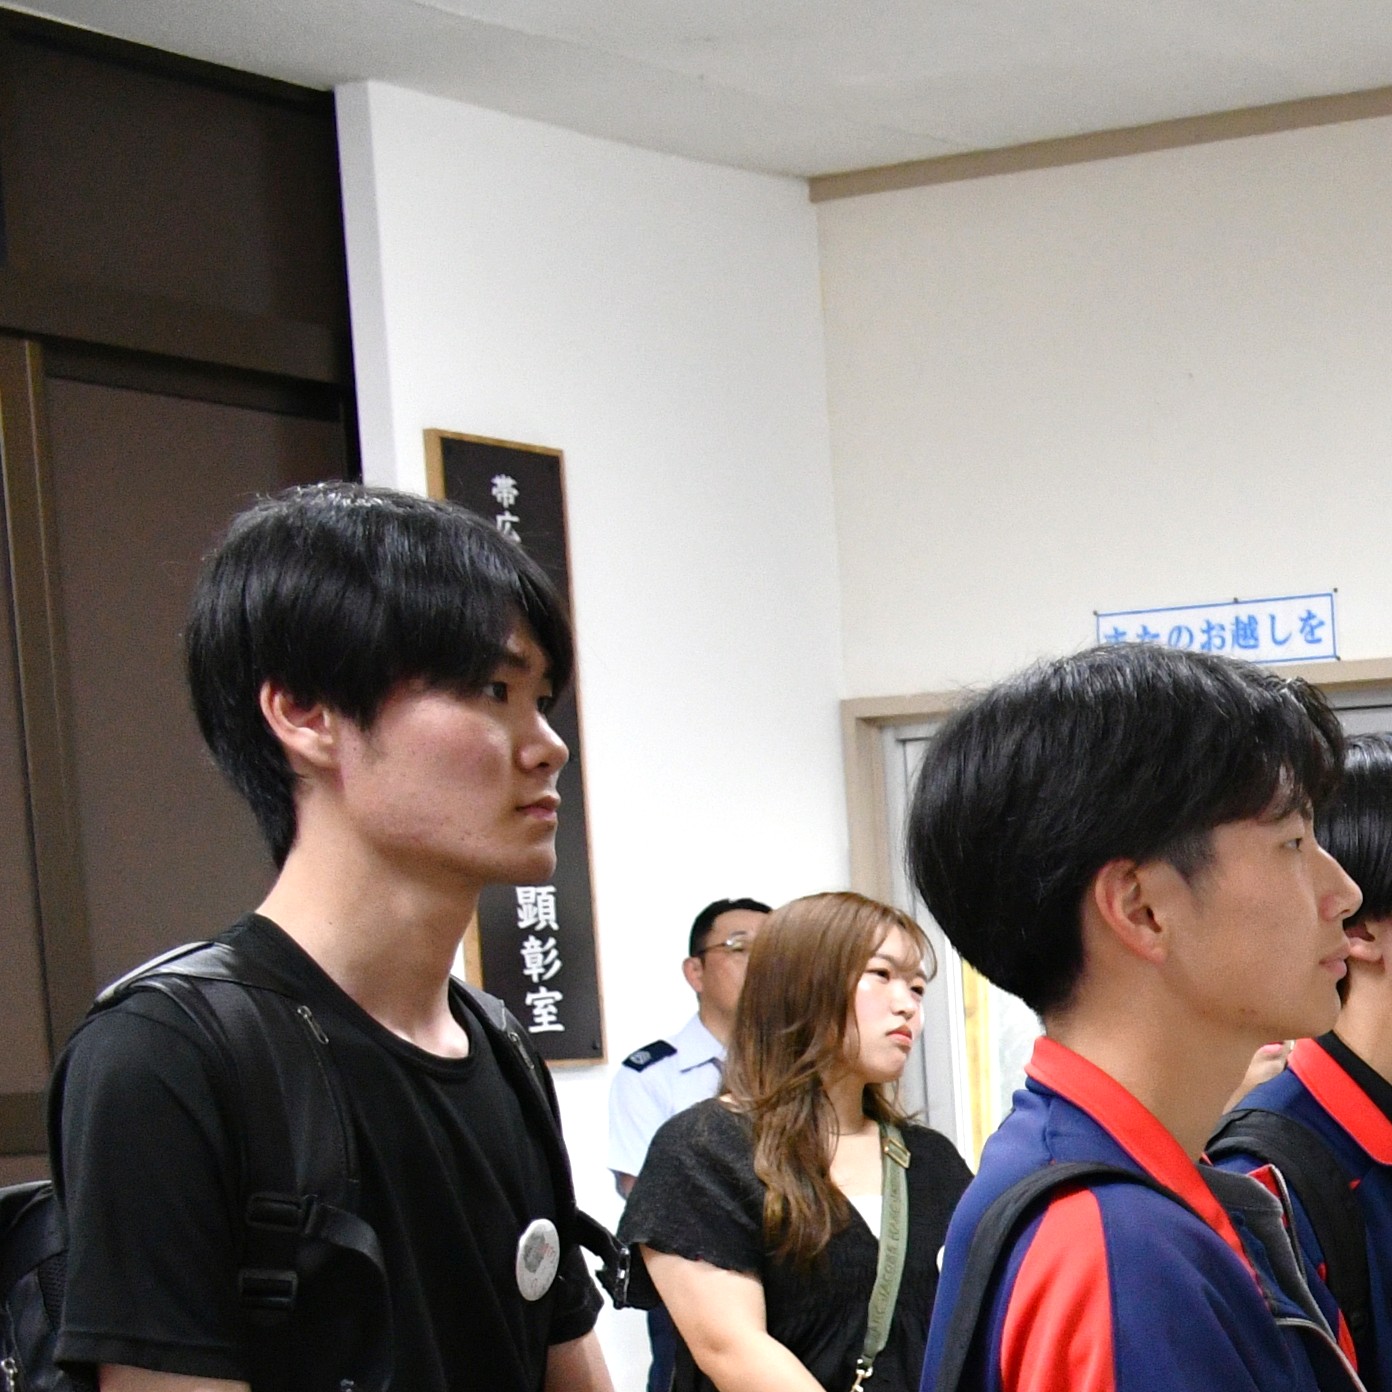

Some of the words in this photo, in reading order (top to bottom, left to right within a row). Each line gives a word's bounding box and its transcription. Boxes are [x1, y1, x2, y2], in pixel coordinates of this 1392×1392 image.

[490, 473, 522, 543] 帯広
[515, 884, 566, 1034] 顕彰室
